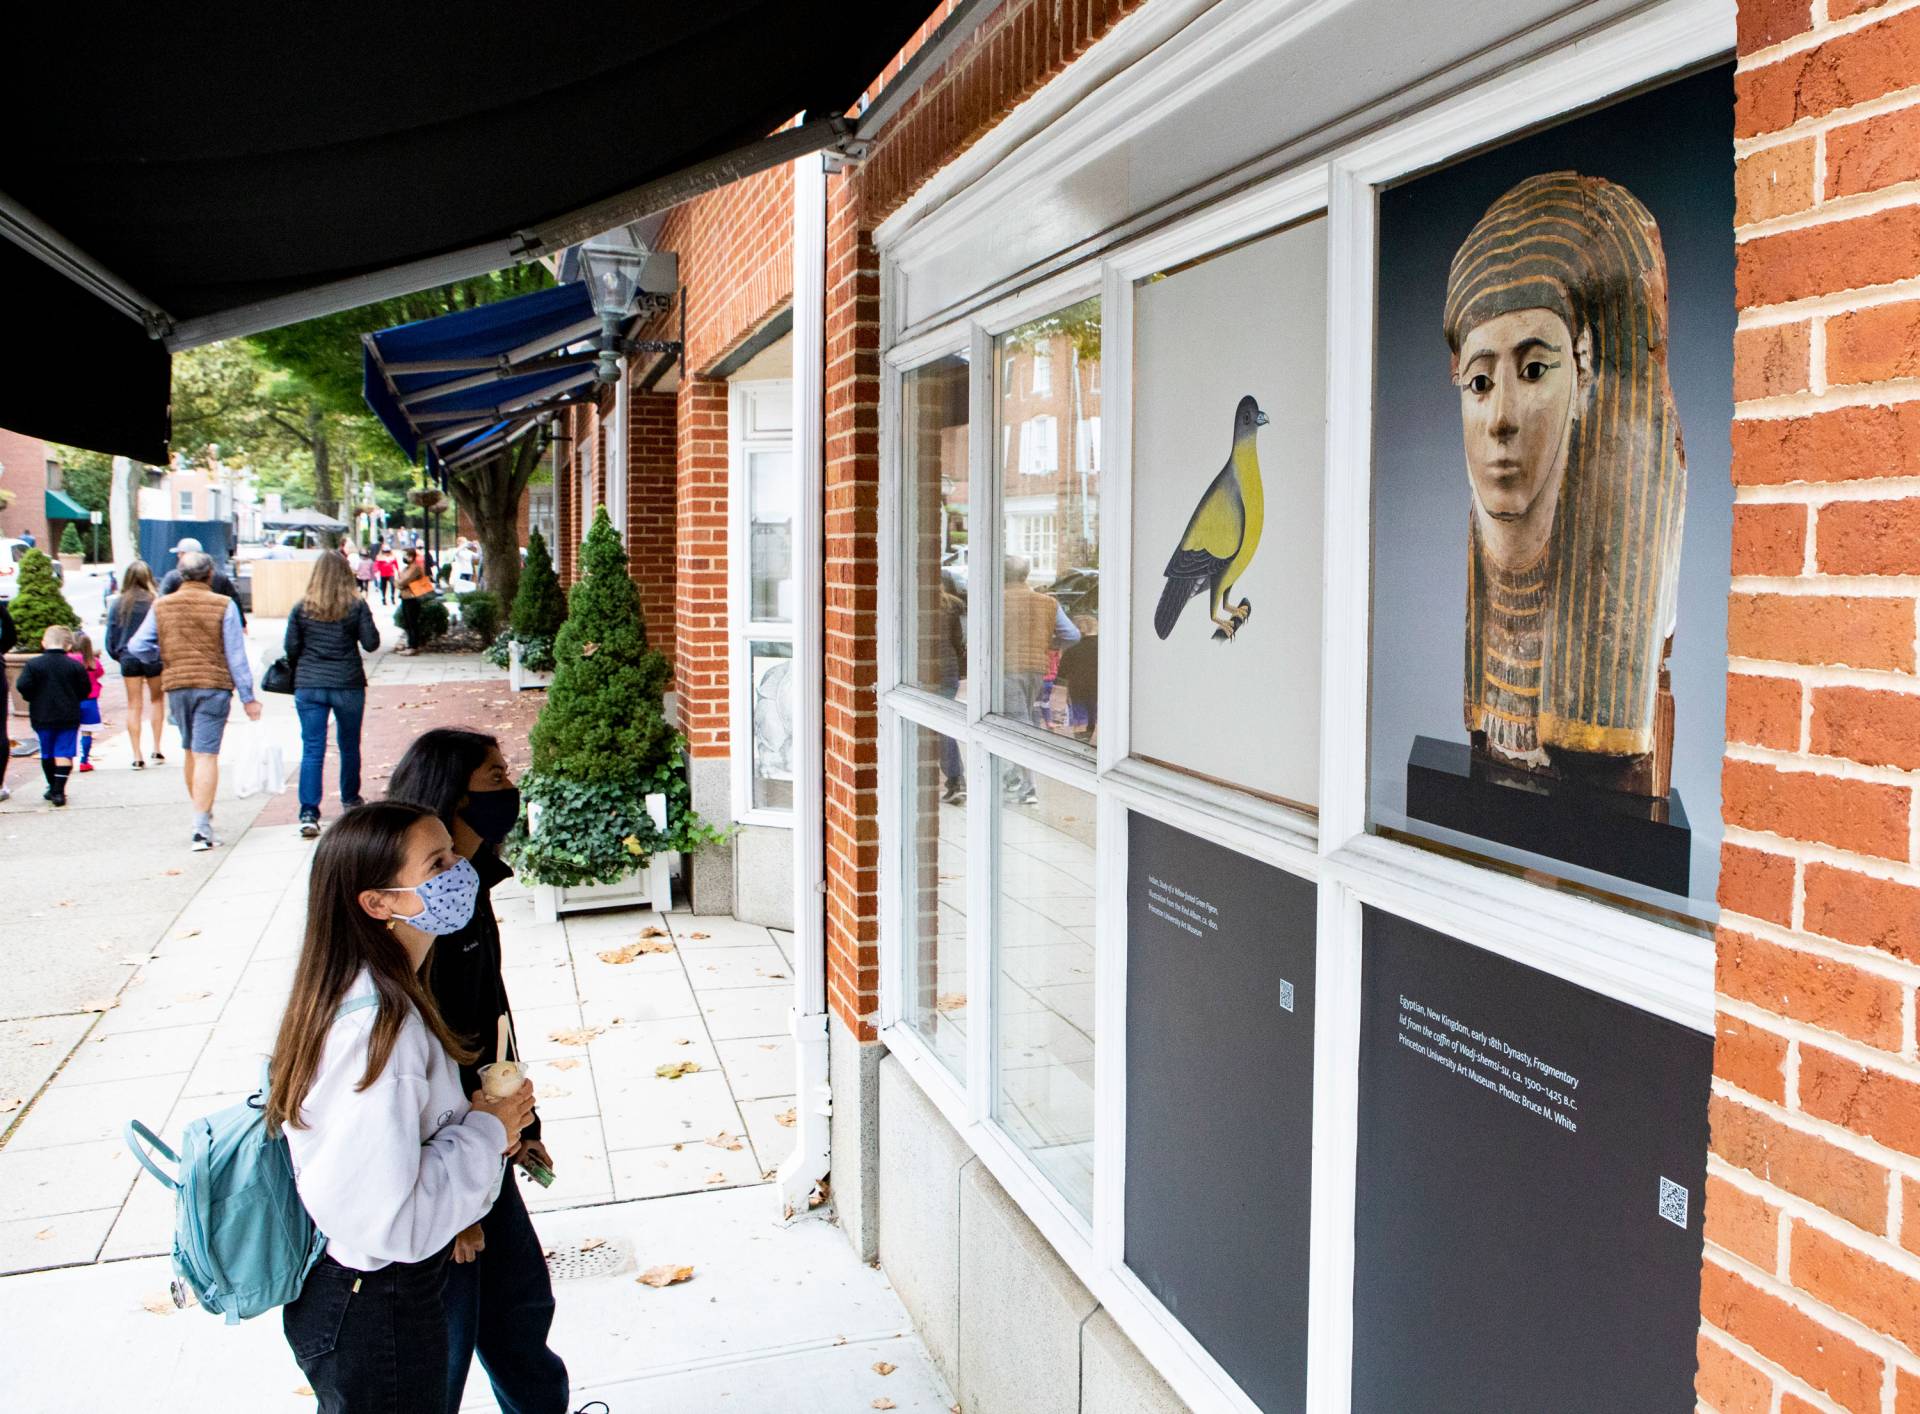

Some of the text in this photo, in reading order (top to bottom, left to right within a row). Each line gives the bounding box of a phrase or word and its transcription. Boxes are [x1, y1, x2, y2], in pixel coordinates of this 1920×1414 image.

[1399, 1013, 1407, 1026] lid
[1407, 1017, 1422, 1033] from
[1422, 1026, 1433, 1038] the
[1433, 1033, 1450, 1047] coffin
[1451, 1041, 1460, 1053] of
[1459, 1043, 1511, 1079] Wadj-shemsi-su,
[1512, 1071, 1523, 1083] ca.
[1564, 1096, 1578, 1110] B.C.
[1399, 1032, 1426, 1054] Princeton
[1427, 1047, 1456, 1072] University
[1456, 1064, 1467, 1077] Art
[1499, 1083, 1521, 1104] Photo:
[1522, 1095, 1542, 1115] Bruce
[1543, 1106, 1553, 1120] M.
[1554, 1112, 1577, 1133] White
[1400, 994, 1579, 1089] Egyptian, New Kingdom, early 18th Dynasty, Fragmentary
